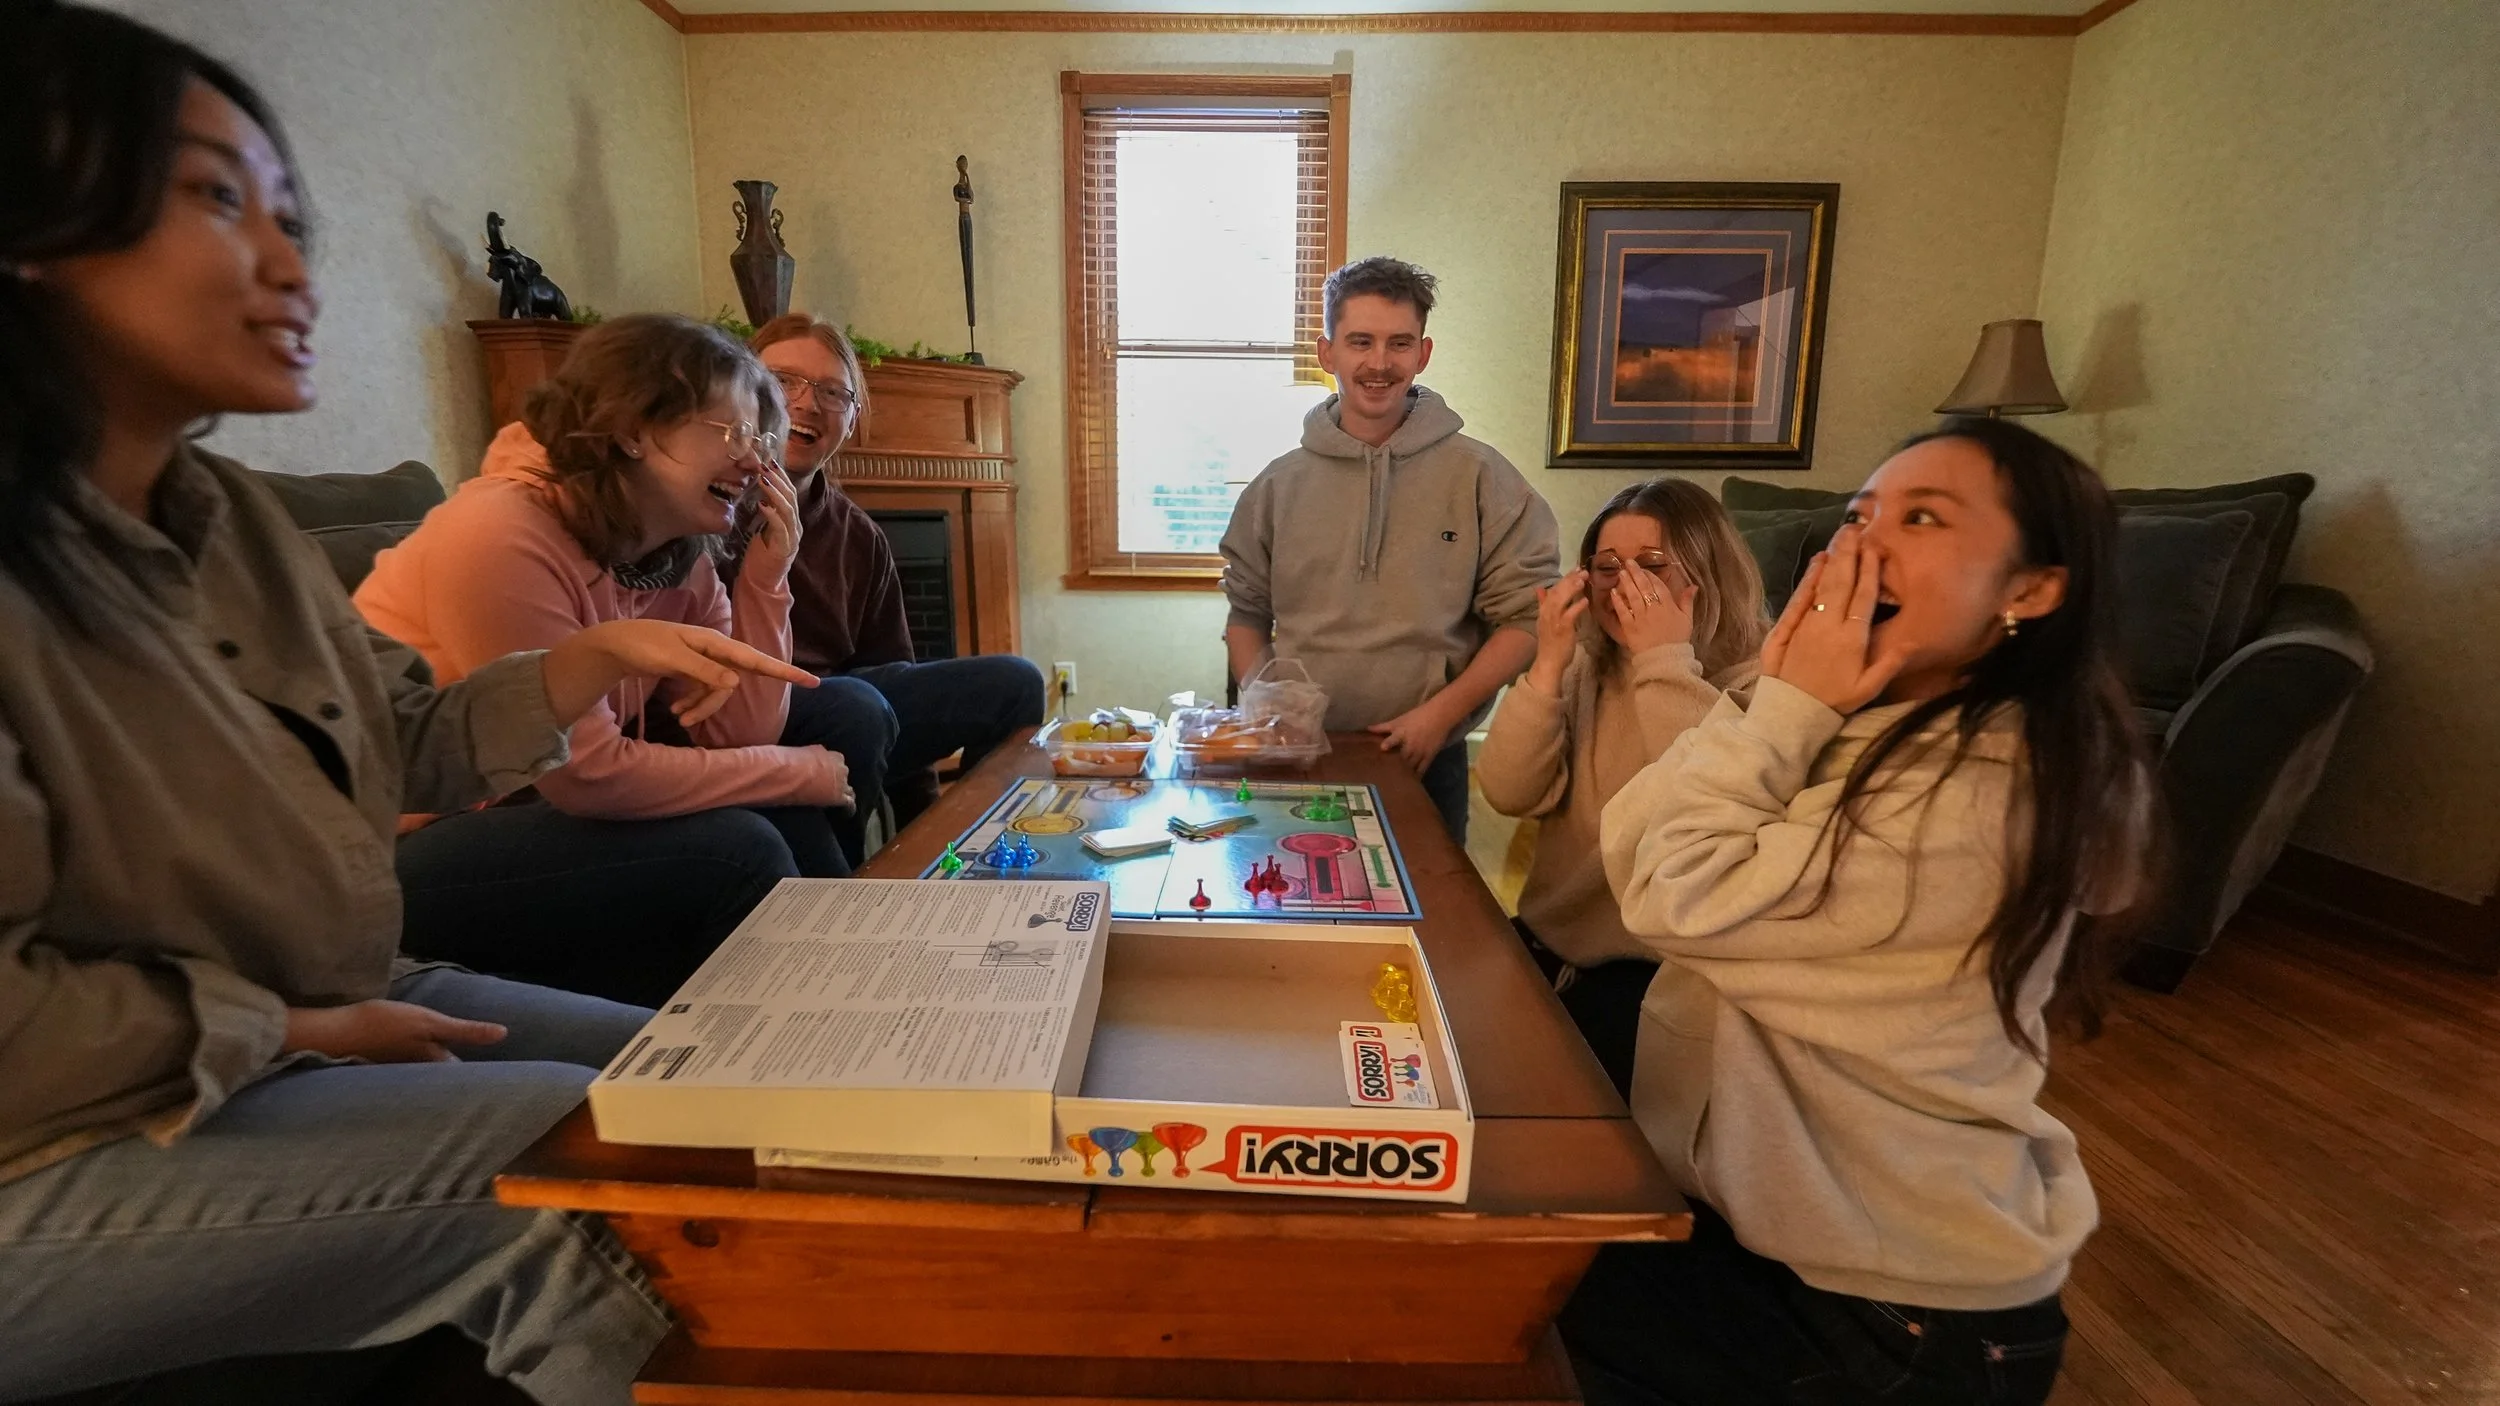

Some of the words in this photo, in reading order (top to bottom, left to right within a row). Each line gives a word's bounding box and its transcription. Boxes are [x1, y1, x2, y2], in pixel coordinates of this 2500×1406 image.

[1071, 894, 1096, 929] SORRY!
[1360, 1045, 1387, 1097] SORRY!
[1245, 1138, 1440, 1180] SORRY!
